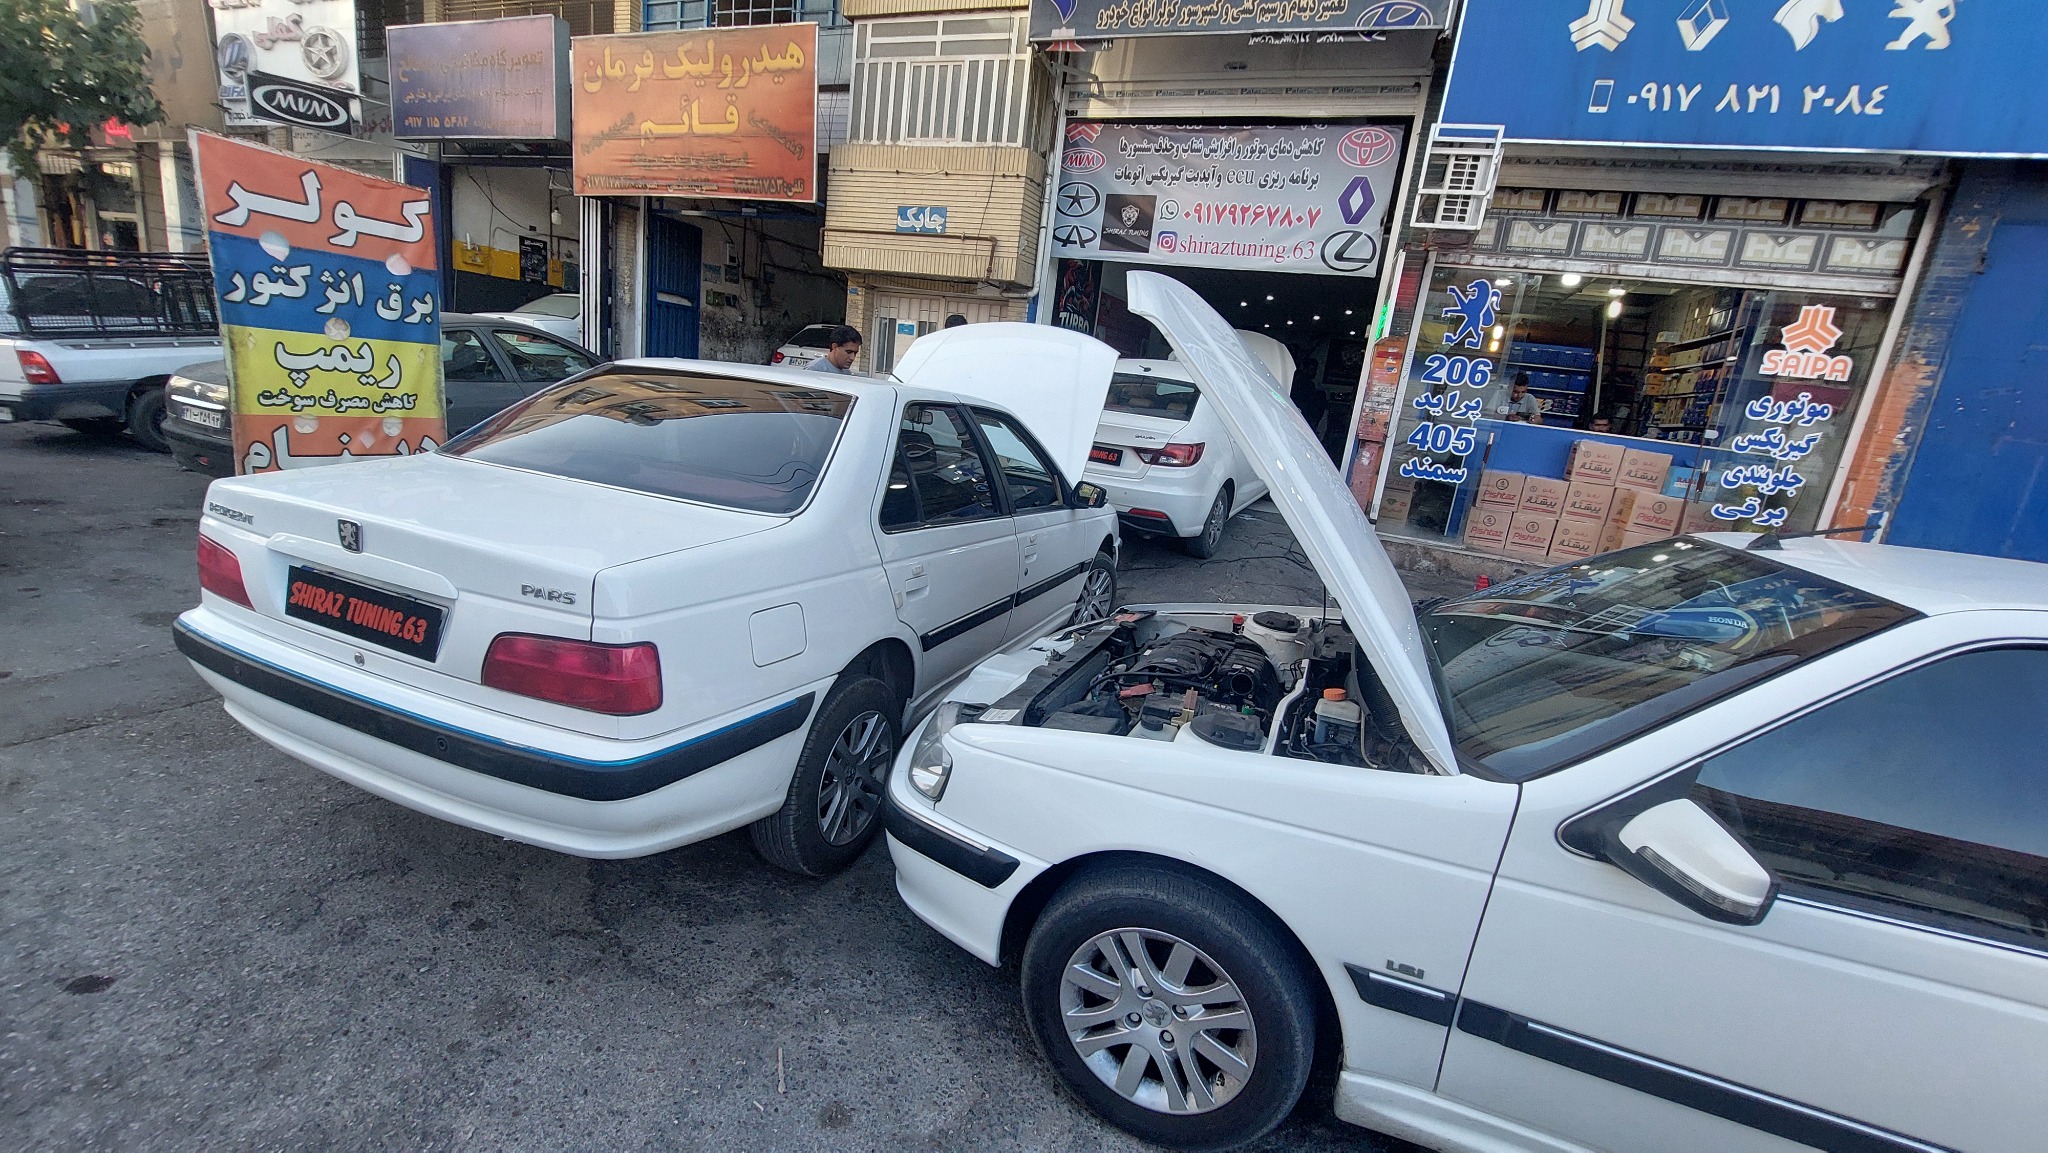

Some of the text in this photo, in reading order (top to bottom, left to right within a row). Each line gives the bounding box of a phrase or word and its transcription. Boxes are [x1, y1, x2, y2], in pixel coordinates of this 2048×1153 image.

[1096, 0, 1130, 30] خودرو
[1128, 0, 1156, 28] انواع
[1153, 0, 1182, 28] کولر
[1231, 0, 1258, 24] کشی
[582, 39, 806, 93] هیدرولیک فرمان
[271, 91, 332, 120] MVM
[1627, 82, 1702, 112] ۰۹۱۷
[1715, 84, 1780, 114] ۸۲۱
[639, 93, 740, 148] قائم
[1064, 152, 1098, 168] MVM
[1181, 137, 1205, 159] شتاب
[1203, 136, 1238, 159] افزایش
[1242, 138, 1269, 160] موتور
[1268, 137, 1295, 160] دمای
[1293, 137, 1326, 161] کاهش
[1114, 164, 1146, 186] اتومات
[1145, 165, 1185, 187] گیربکس
[1226, 169, 1255, 184] ecu
[1258, 170, 1286, 190] ریزی
[1288, 167, 1320, 191] برنامه
[214, 169, 431, 248] کولر
[896, 206, 946, 234] چابک
[1182, 201, 1323, 230] ۰۹۱۷۹۲۶۷۸۰۷
[1178, 234, 1316, 264] shiraztuning.63
[375, 282, 435, 325] برق
[1058, 311, 1091, 335] TURBO
[274, 341, 403, 389] ریمپ
[1421, 353, 1493, 389] 206
[1760, 350, 1853, 382] SAIPA
[257, 387, 418, 414] کاهش مصرف سوخت
[1412, 391, 1483, 420] پراید
[1746, 392, 1832, 426] موتوری
[1407, 421, 1478, 456] 405
[1732, 427, 1823, 460] گیربکس
[1400, 457, 1468, 484] سمند
[1721, 464, 1805, 498] جلوبندی
[1482, 488, 1517, 501] Pishtaz
[1636, 512, 1674, 527] Pishtaz
[1711, 496, 1788, 526] برقی
[1470, 526, 1504, 538] Pishtaz
[1512, 531, 1547, 544] Pishtaz
[520, 582, 577, 605] PARS
[289, 581, 428, 644] SHIRAZ TUNING.63
[1708, 616, 1749, 629] HONDA
